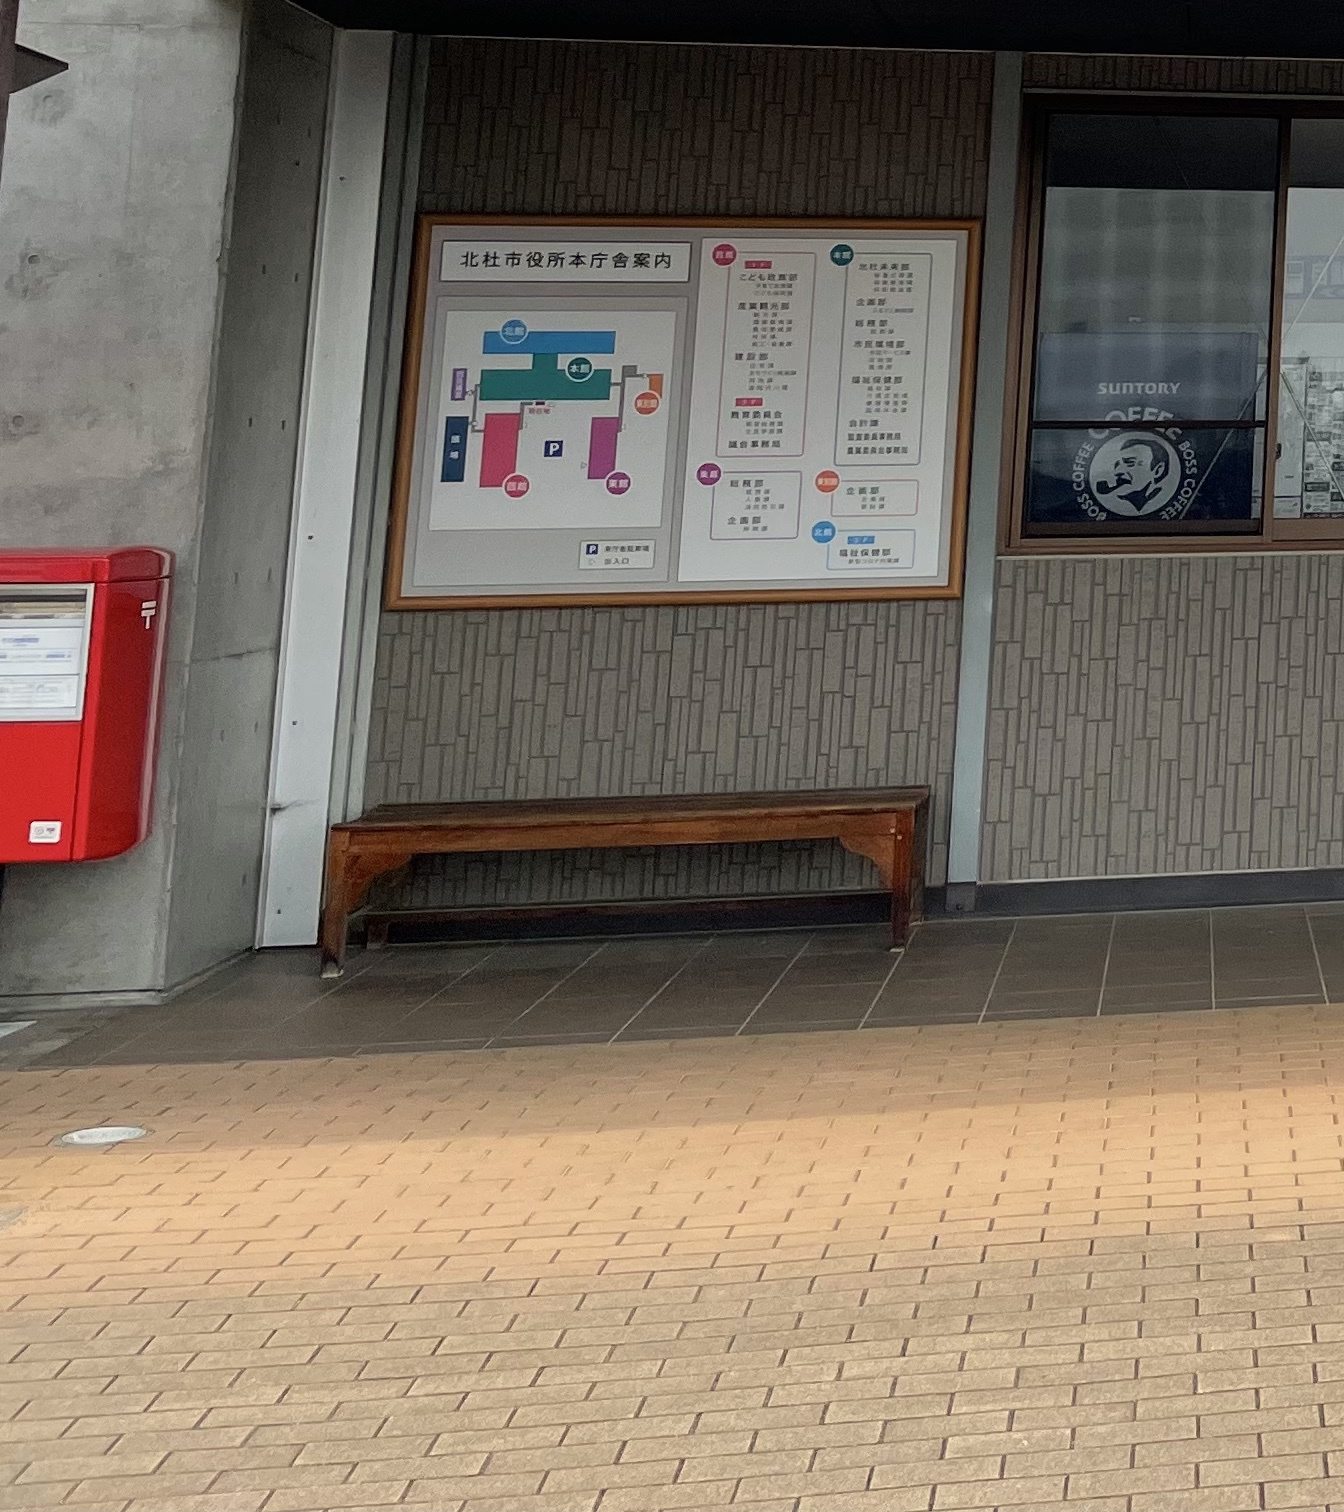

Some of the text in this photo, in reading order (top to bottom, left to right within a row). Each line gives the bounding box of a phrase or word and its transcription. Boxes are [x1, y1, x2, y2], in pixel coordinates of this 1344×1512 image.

[460, 251, 671, 269] 北杜市役所本庁舎案内
